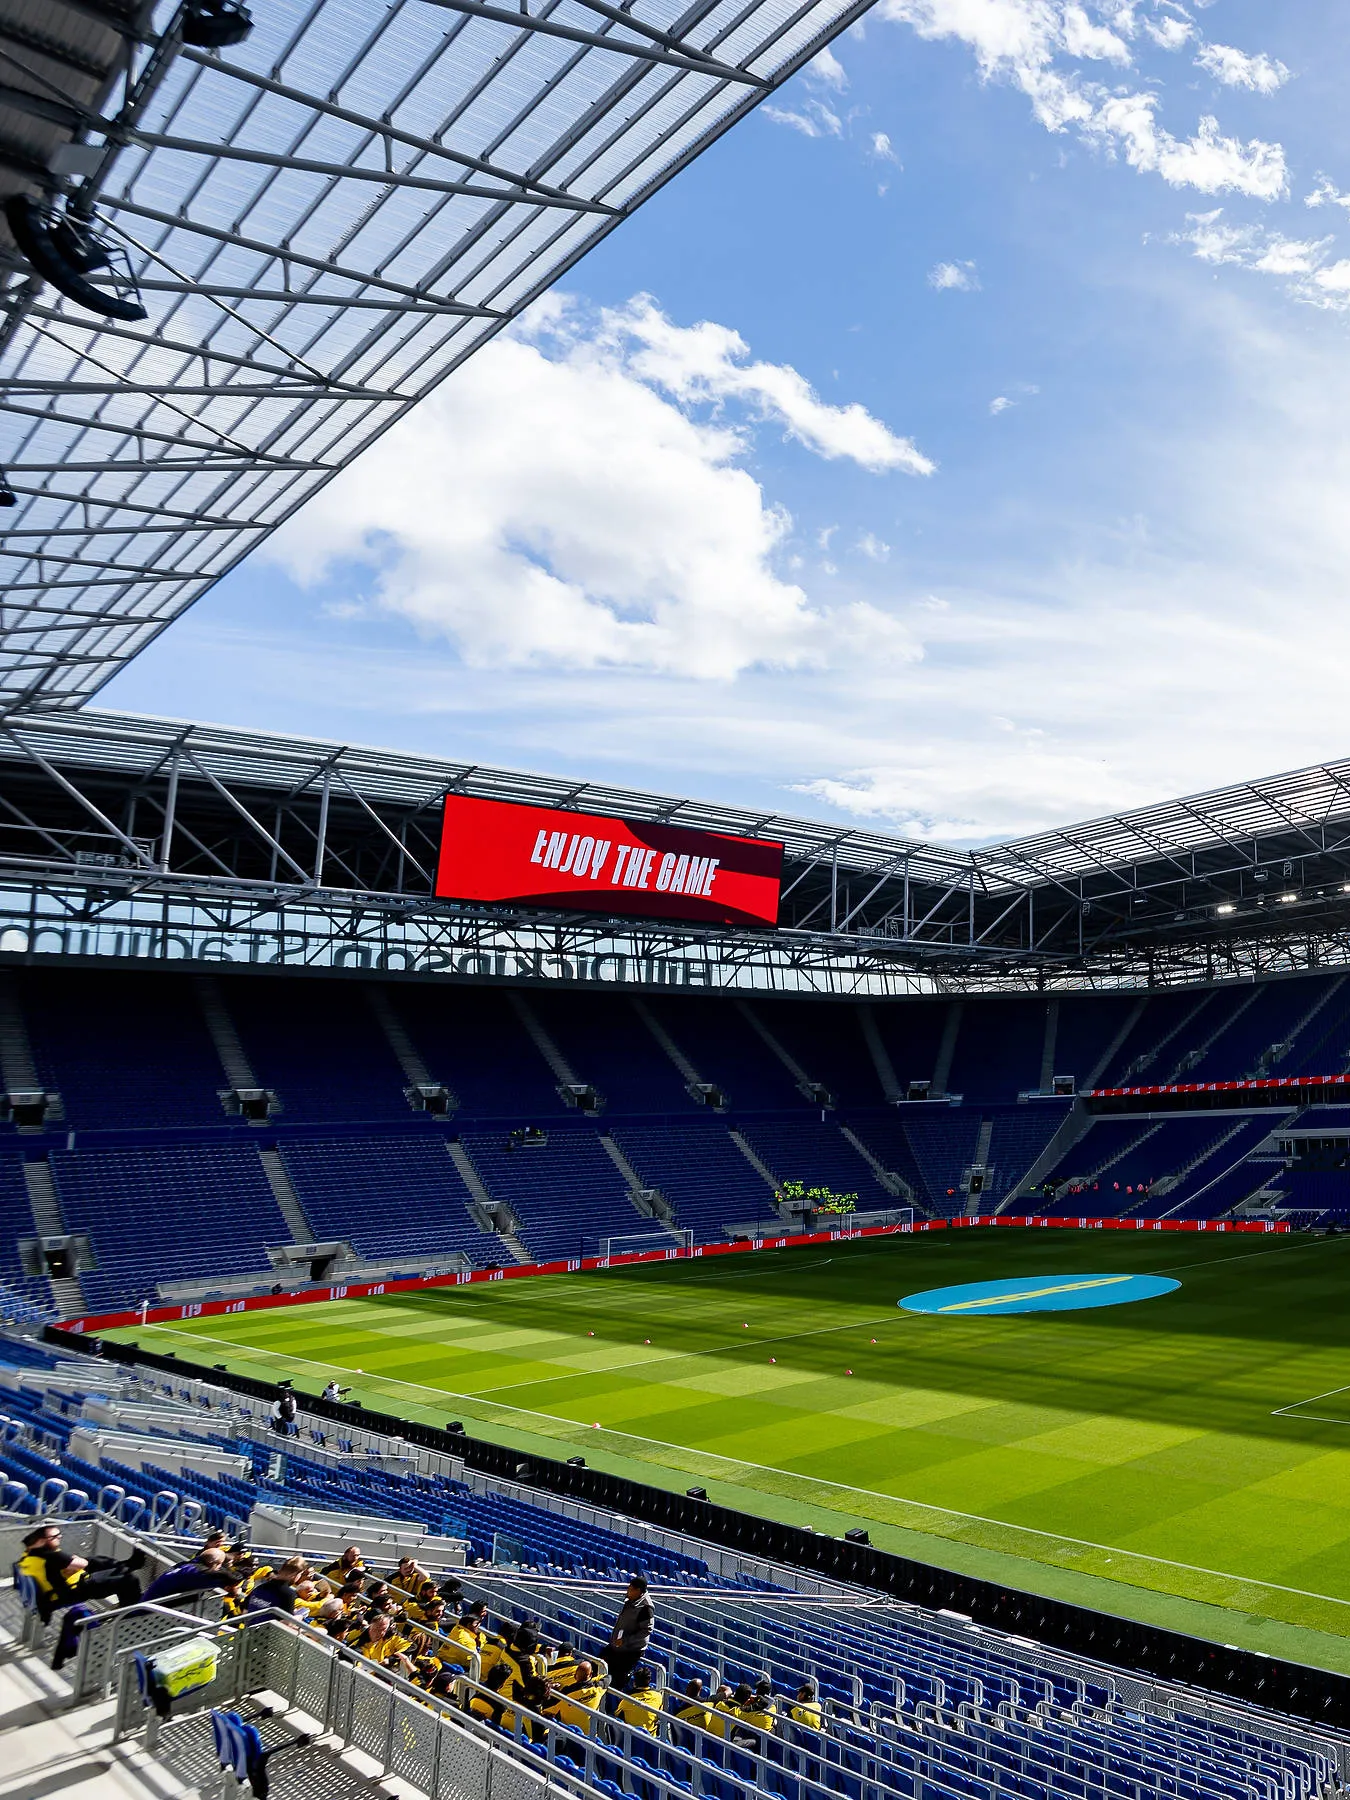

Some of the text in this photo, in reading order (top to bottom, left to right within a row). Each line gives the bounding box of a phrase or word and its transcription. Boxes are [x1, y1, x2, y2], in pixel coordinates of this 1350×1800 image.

[530, 829, 721, 897] ENJOY THE GAME
